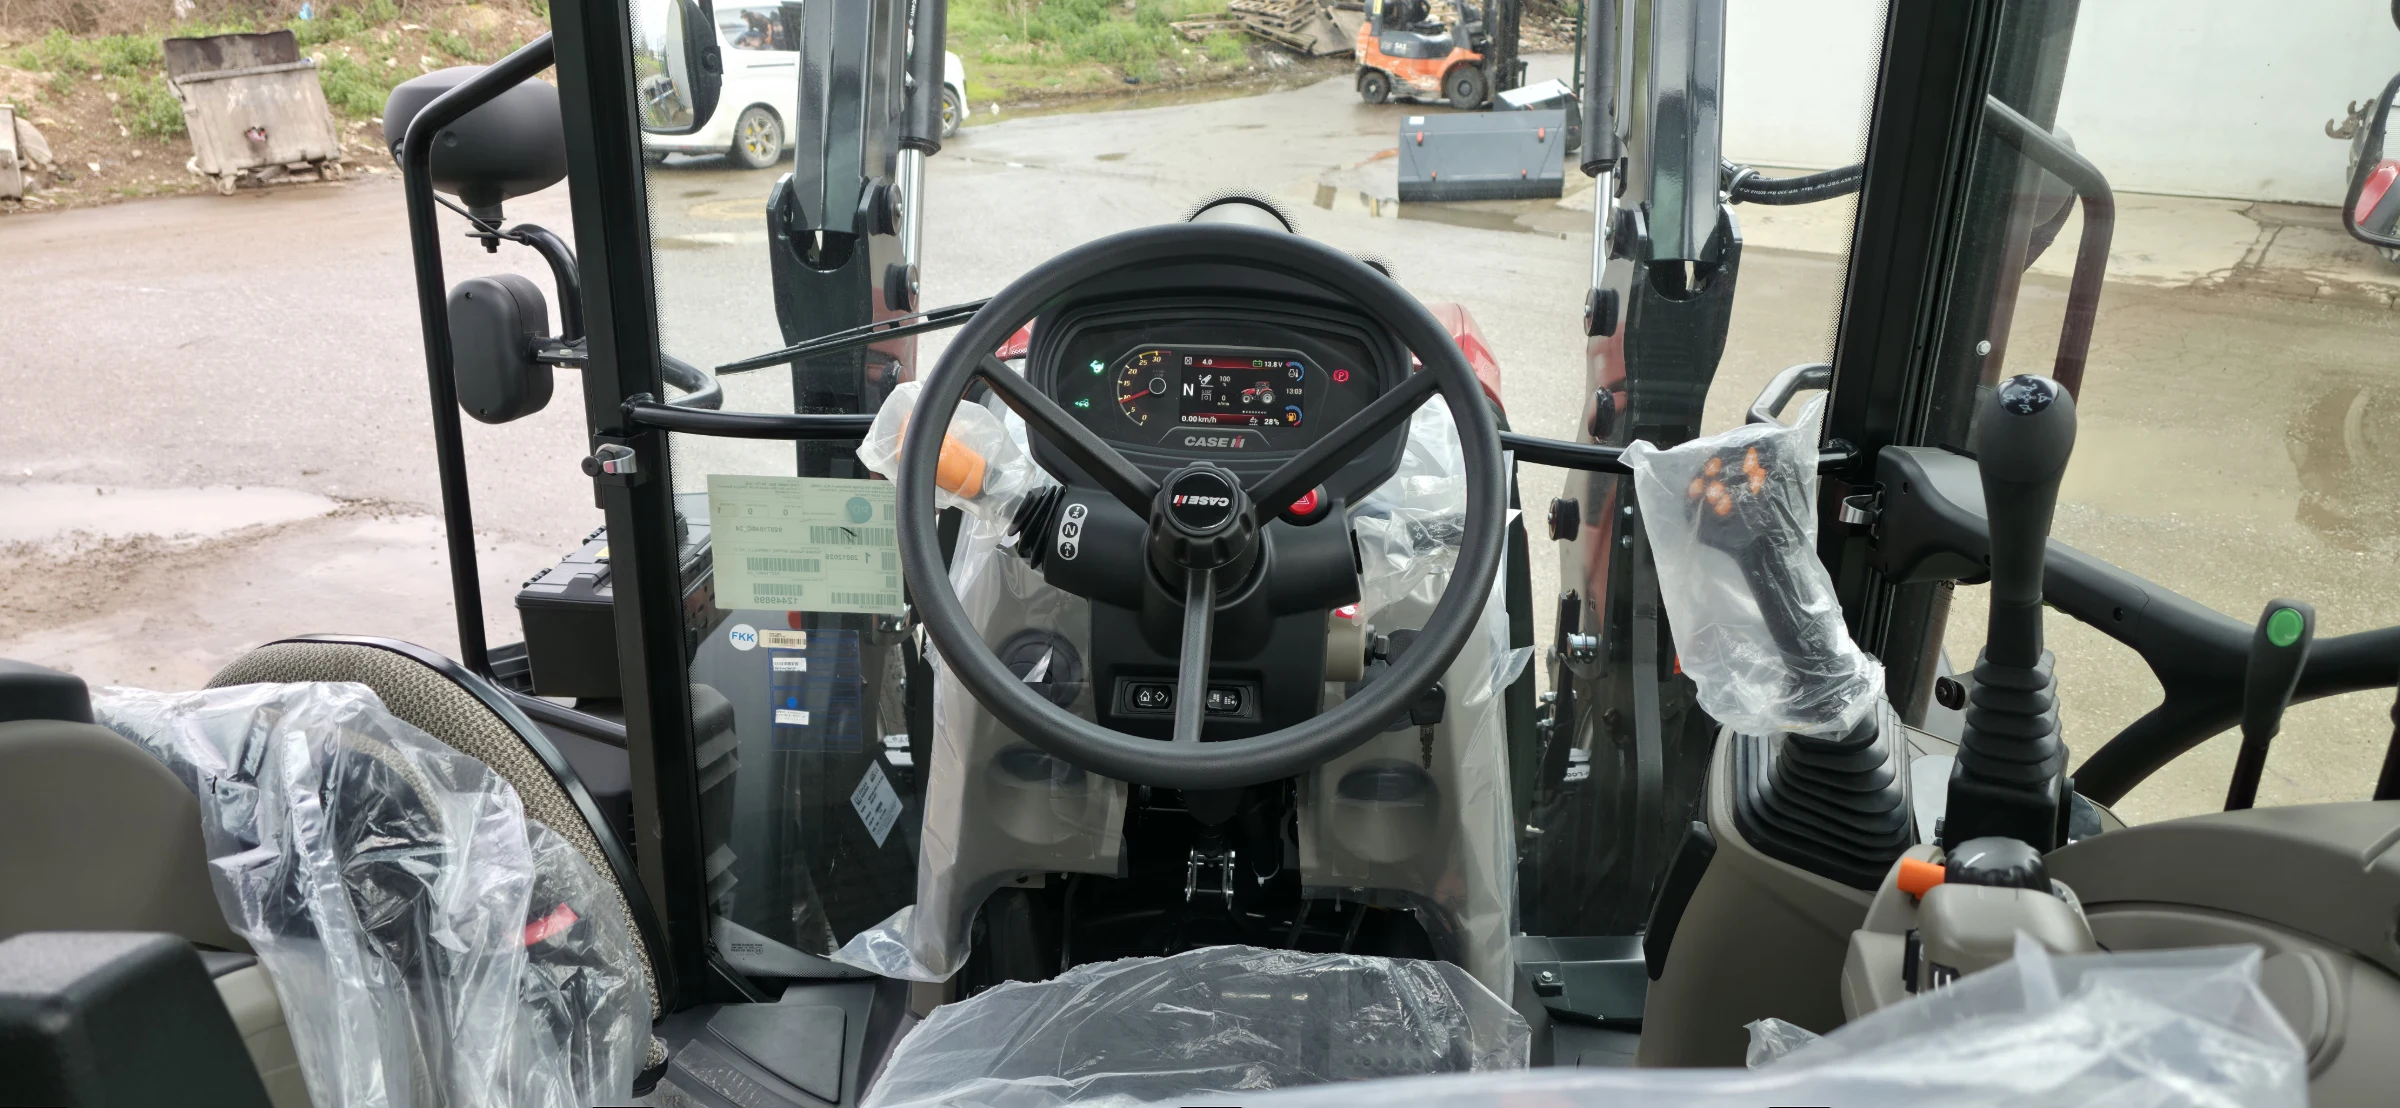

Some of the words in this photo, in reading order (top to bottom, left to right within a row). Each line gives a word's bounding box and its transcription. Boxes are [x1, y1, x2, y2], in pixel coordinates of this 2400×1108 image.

[1183, 383, 1194, 396] N
[1184, 436, 1230, 448] CASE
[1188, 496, 1230, 507] CASE
[1064, 524, 1076, 536] N
[731, 631, 754, 642] FKK
